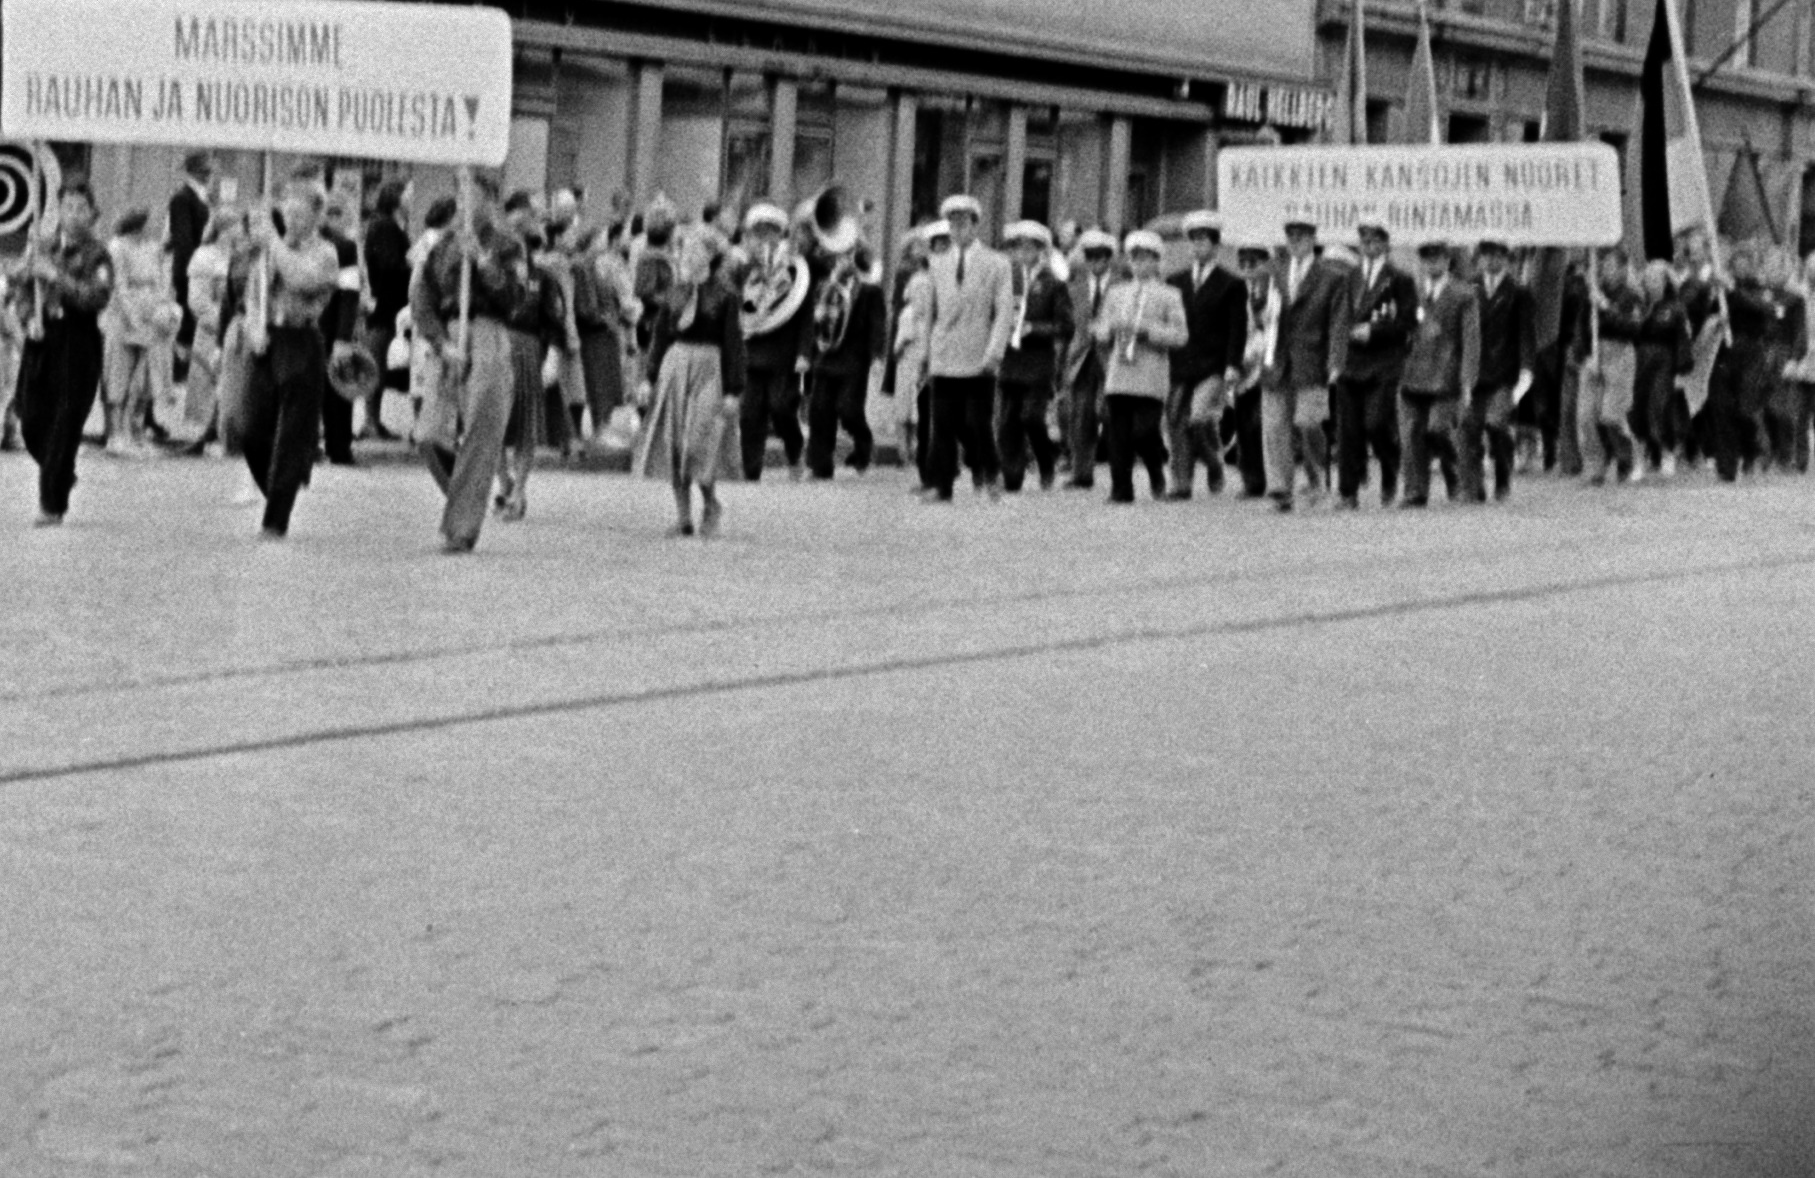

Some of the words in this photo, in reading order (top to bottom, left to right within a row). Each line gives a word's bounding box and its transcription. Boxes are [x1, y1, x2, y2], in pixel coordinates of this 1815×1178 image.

[174, 15, 343, 69] MARSSIMME
[26, 74, 143, 119] RAUHAN
[152, 78, 183, 122] JA
[195, 80, 330, 132] NUORISON
[1230, 163, 1348, 190] KAIKKIEN
[1365, 161, 1490, 191] KANSOJEN
